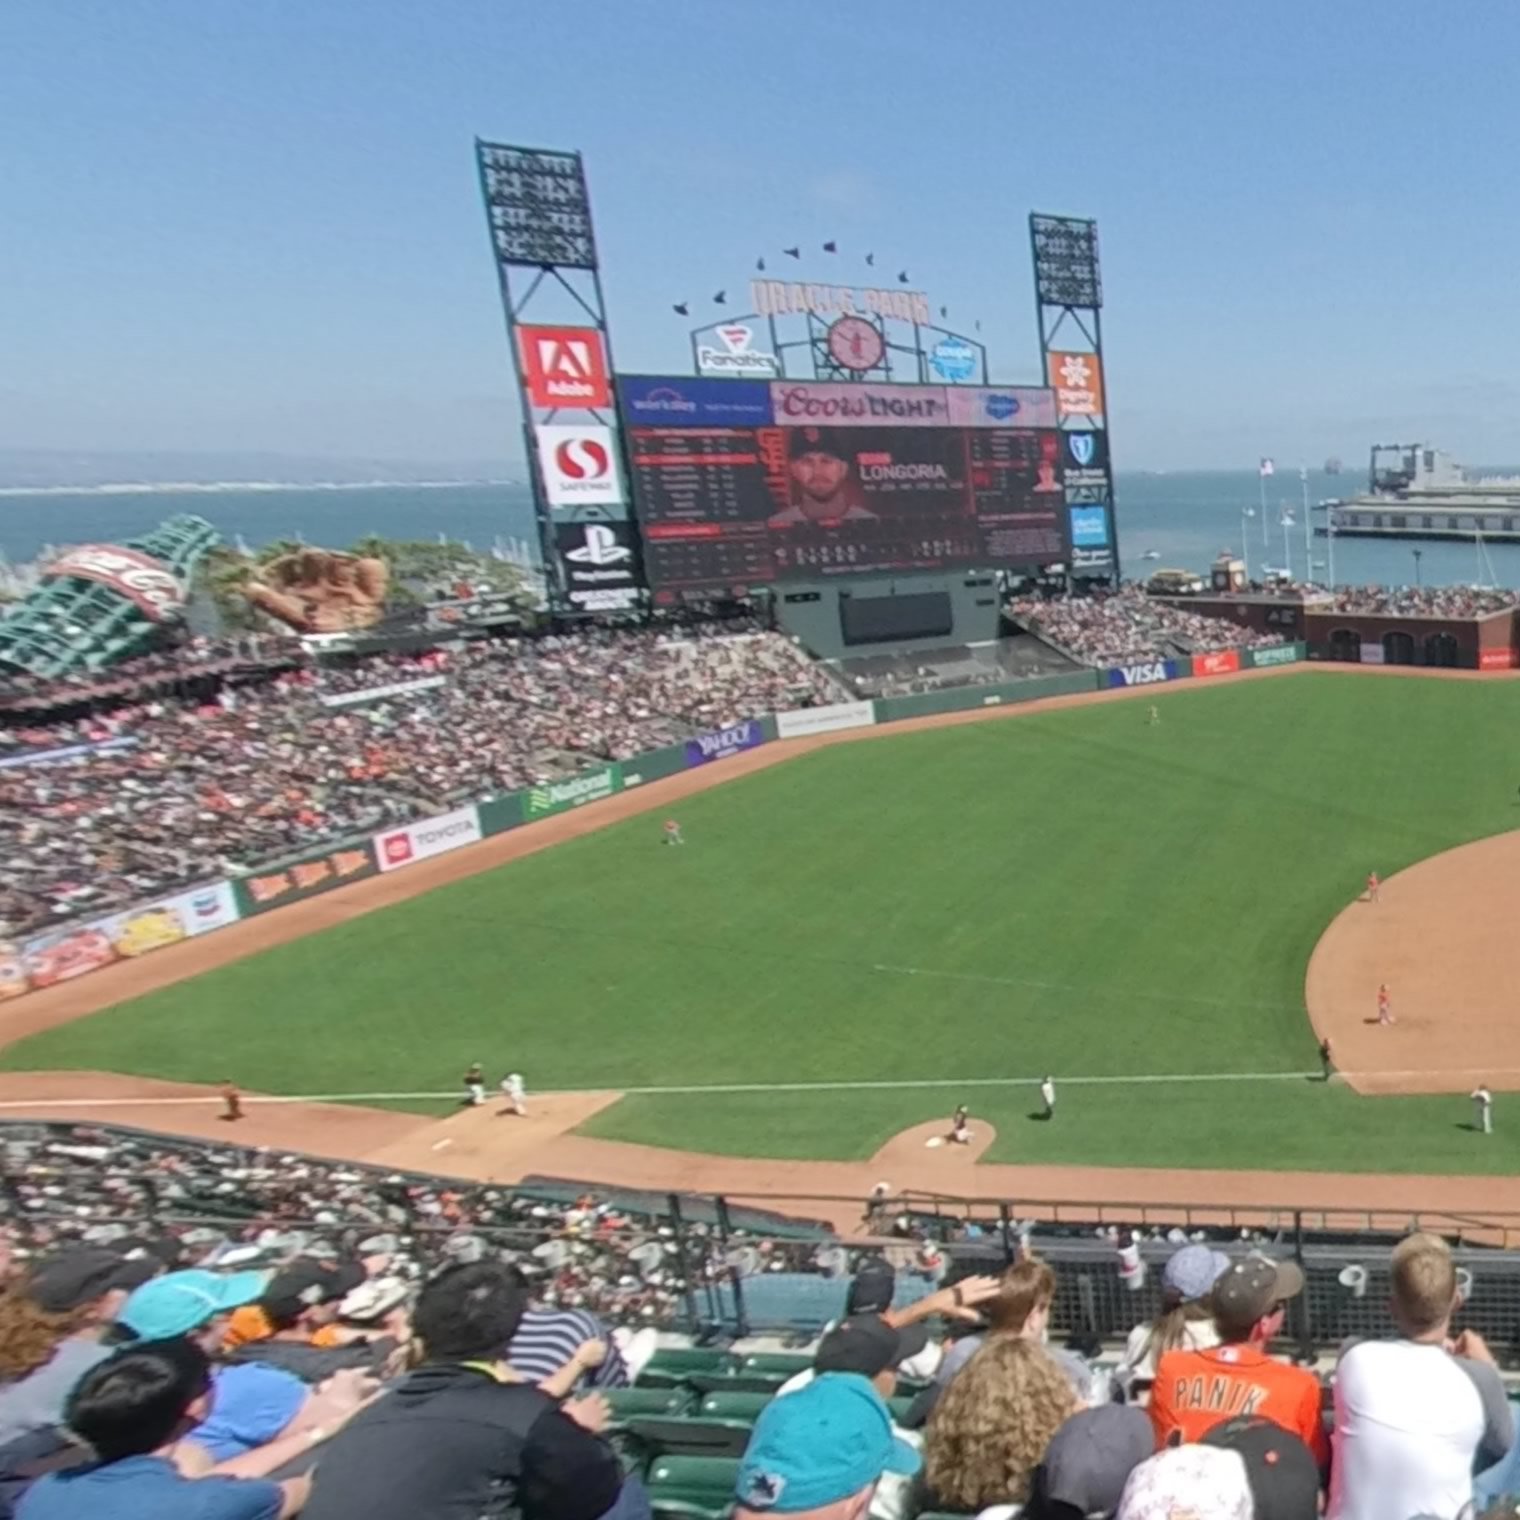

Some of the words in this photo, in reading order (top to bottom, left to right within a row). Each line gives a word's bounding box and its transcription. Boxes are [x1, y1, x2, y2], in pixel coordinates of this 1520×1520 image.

[751, 279, 856, 316] ORACLE
[863, 287, 930, 325] PARK
[701, 350, 777, 369] Fanatics
[546, 379, 595, 397] Adobe
[777, 386, 864, 418] Coors
[864, 391, 937, 417] LIGHT
[859, 464, 947, 480] LONGORIA
[559, 482, 612, 491] SAFEWAY
[1120, 662, 1167, 685] VISA
[696, 725, 750, 756] YAHOO!
[415, 820, 474, 846] TOYOTA
[1174, 1374, 1269, 1416] PANIK
